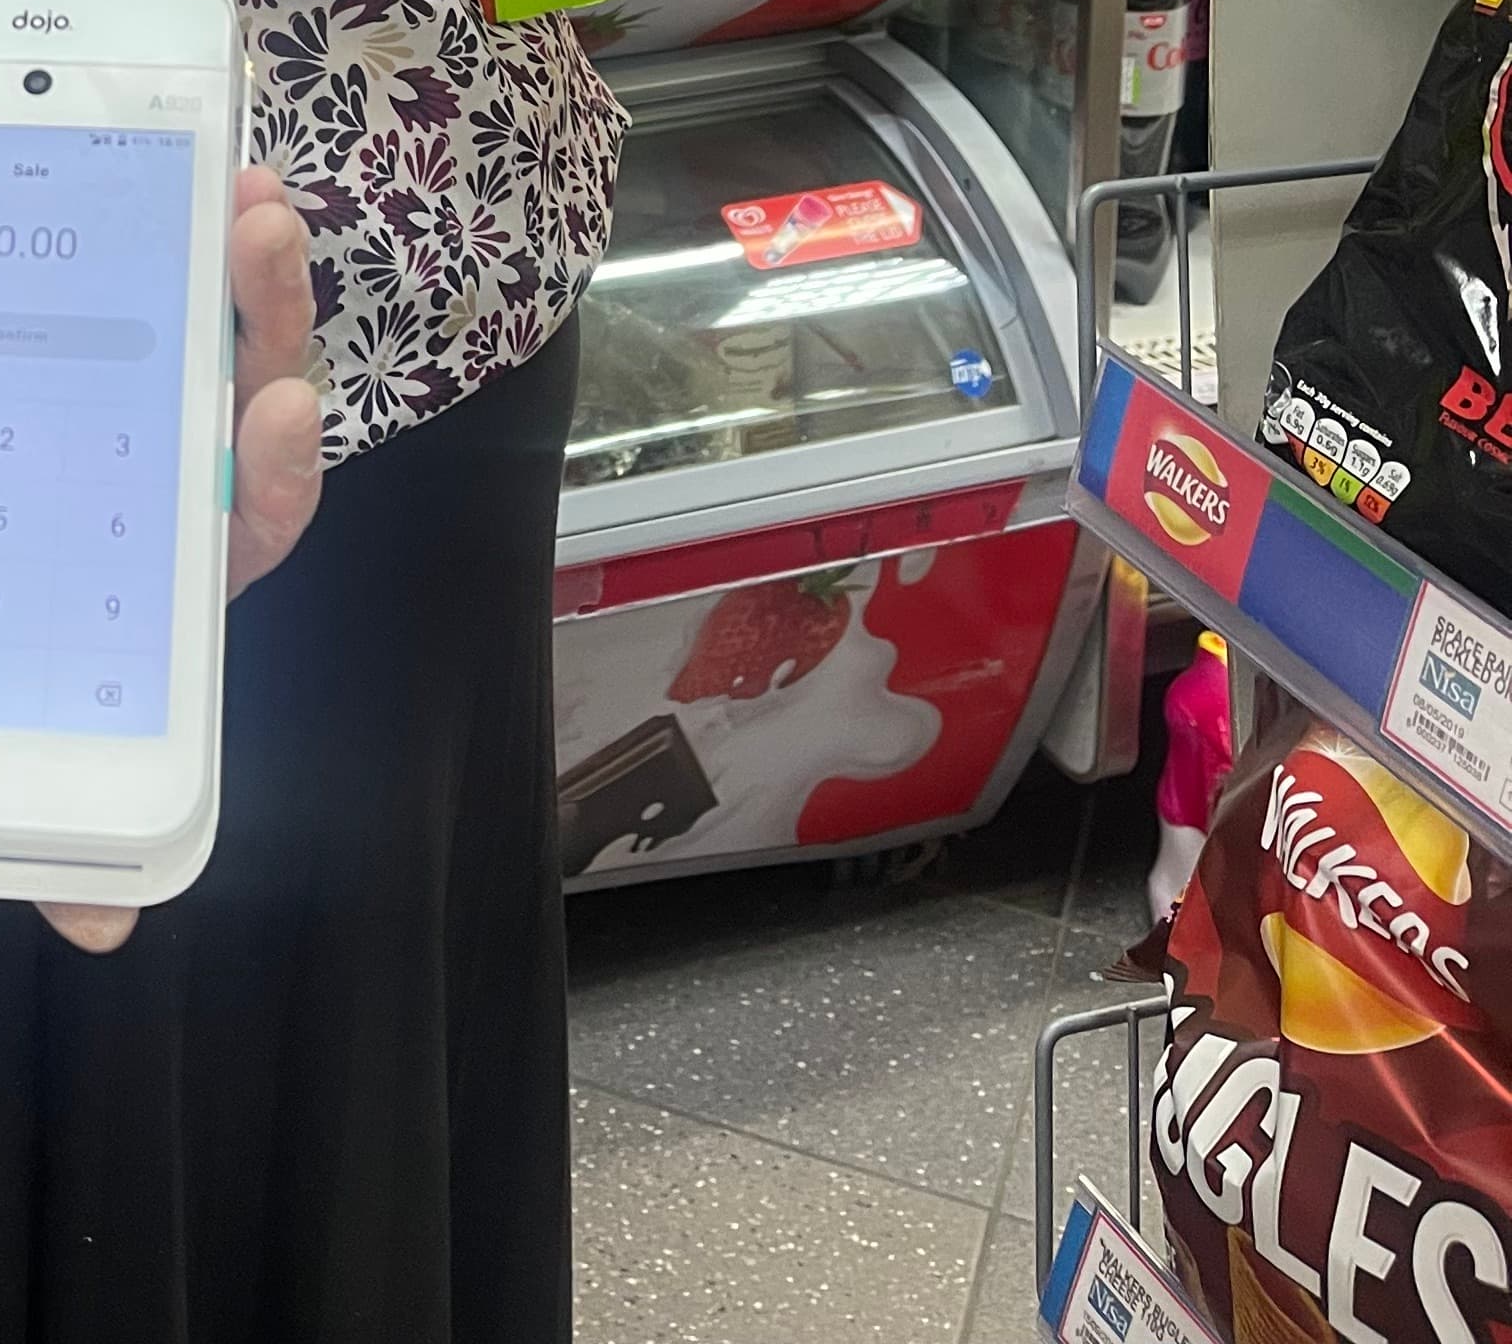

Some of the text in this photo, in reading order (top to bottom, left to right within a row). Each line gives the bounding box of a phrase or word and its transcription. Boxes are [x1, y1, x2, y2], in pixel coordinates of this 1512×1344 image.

[13, 162, 50, 179] Sale
[0, 427, 15, 452] 2
[116, 433, 131, 458] 3
[1147, 443, 1230, 525] WALKERS
[111, 513, 126, 538] 6
[105, 596, 121, 621] 9
[1431, 625, 1491, 685] PICKLED
[1437, 615, 1484, 658] SPACE
[1422, 654, 1476, 715] Nisa
[1261, 763, 1471, 1002] WALKERS
[1152, 974, 1512, 1344] UGLES
[1090, 1276, 1129, 1334] Nisa
[1098, 1262, 1139, 1314] CHEESE
[1099, 1246, 1153, 1309] WALKERS
